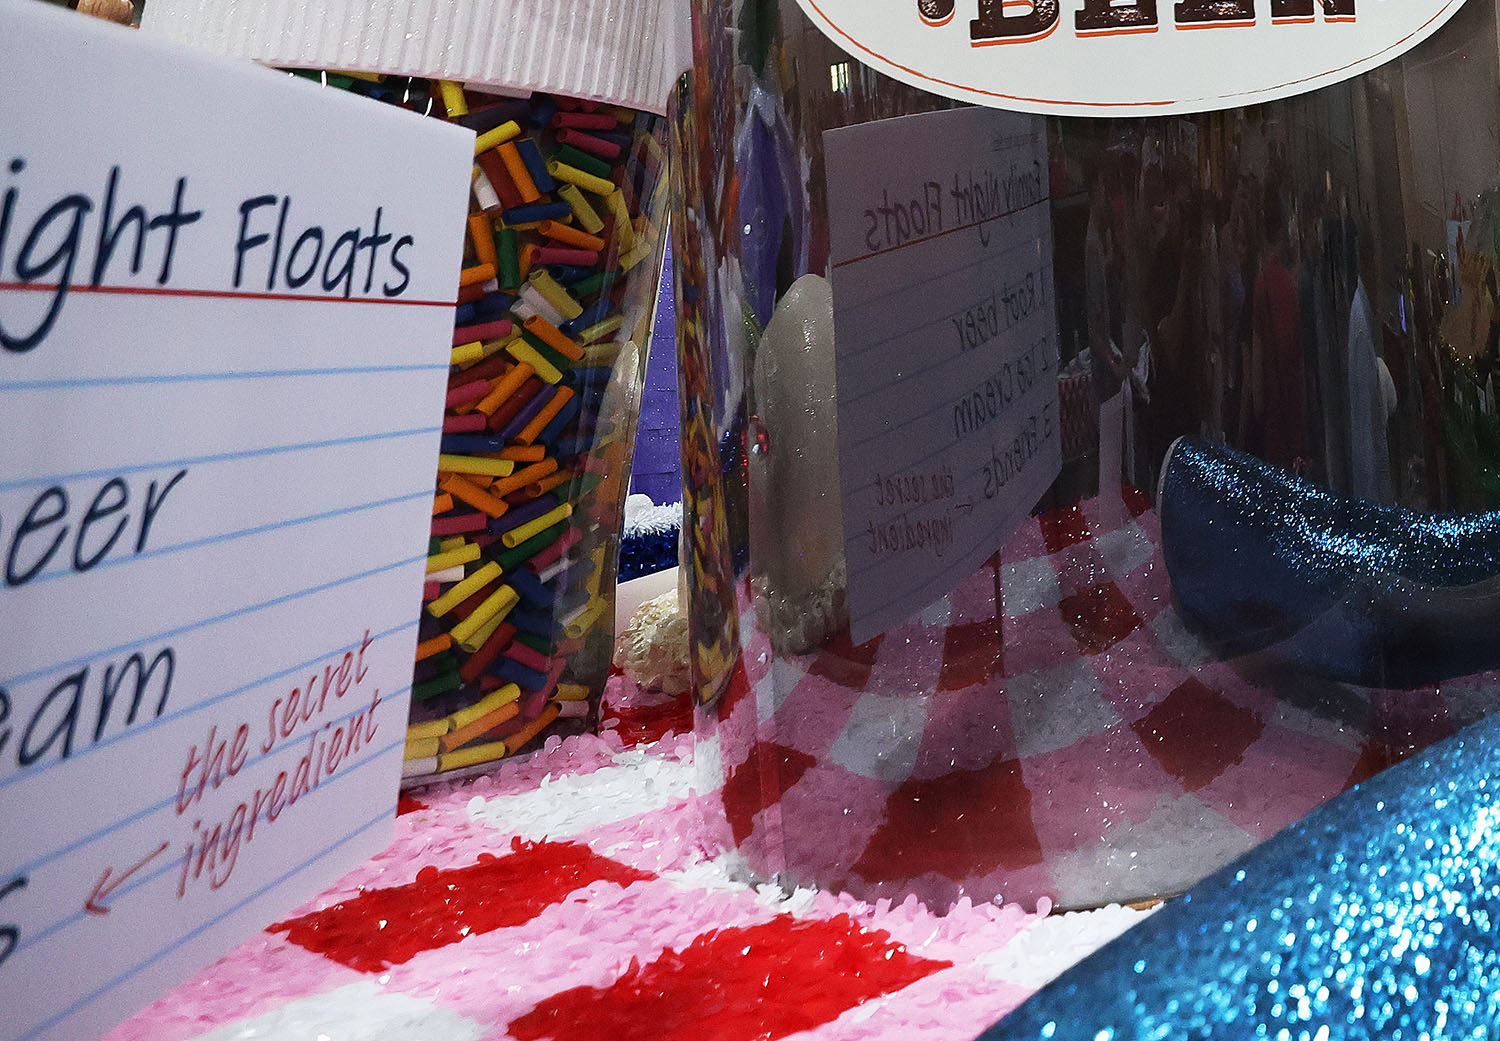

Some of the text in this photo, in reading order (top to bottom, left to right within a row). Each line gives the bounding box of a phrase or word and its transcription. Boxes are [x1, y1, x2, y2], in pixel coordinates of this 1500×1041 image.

[232, 195, 414, 299] Floats
[1, 469, 188, 586] eer
[175, 629, 374, 816] the secret
[176, 688, 383, 900] ingredient
